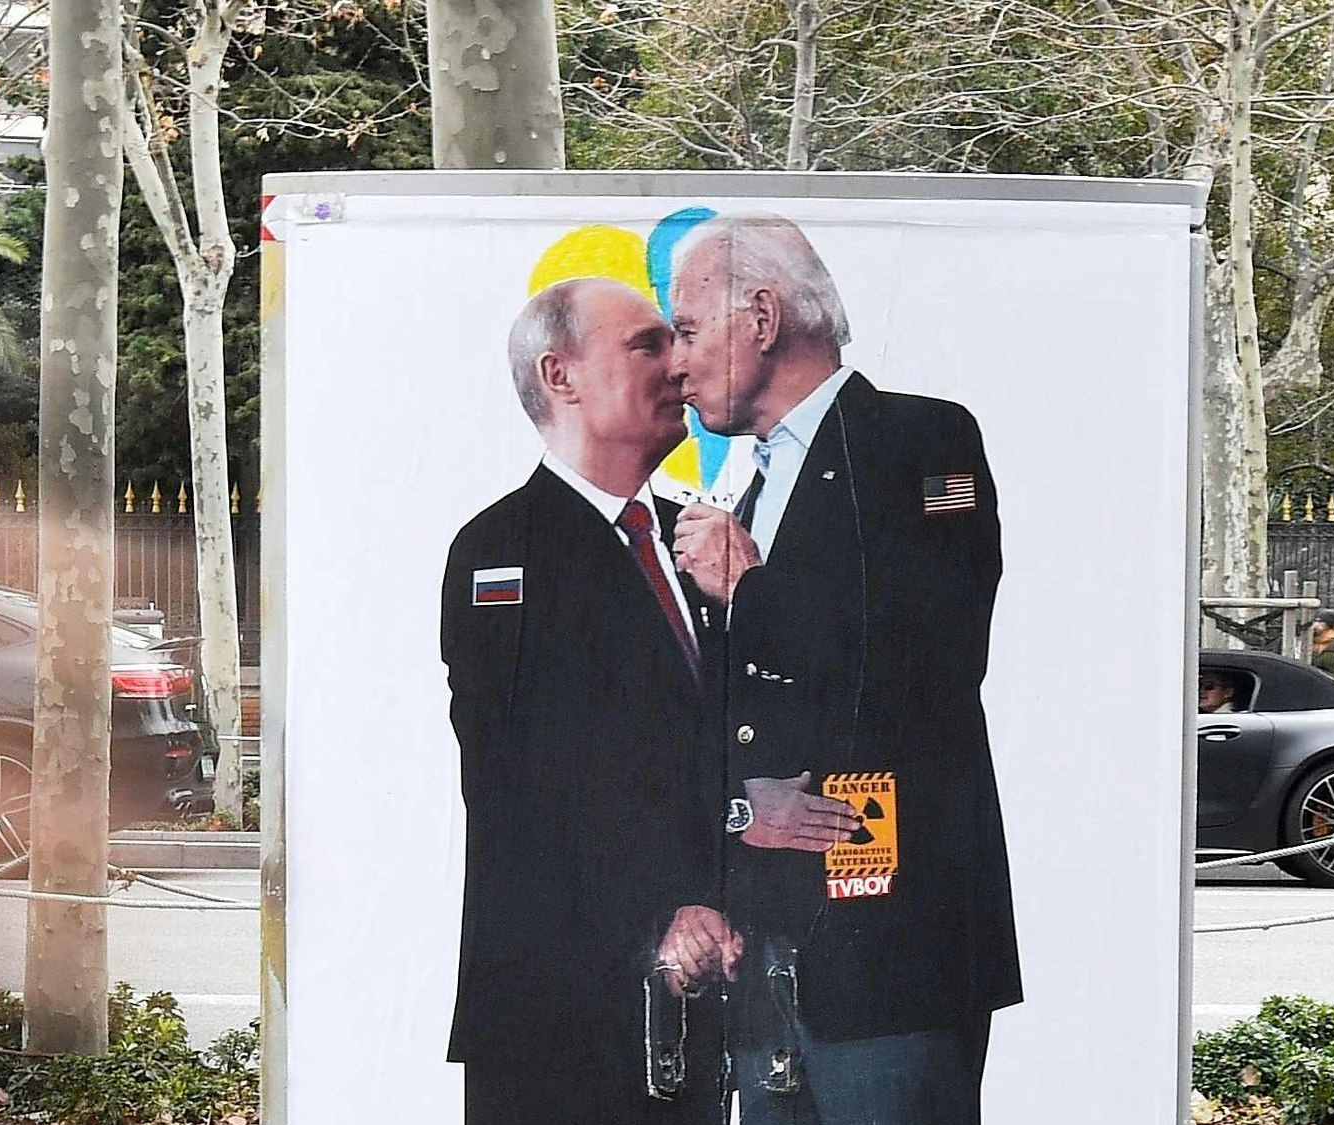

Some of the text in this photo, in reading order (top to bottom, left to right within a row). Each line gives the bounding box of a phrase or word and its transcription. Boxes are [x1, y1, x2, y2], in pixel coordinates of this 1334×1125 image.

[828, 781, 891, 795] DANGER
[830, 846, 892, 857] RADIOACTIVE
[831, 855, 893, 866] MATERIALS
[827, 874, 892, 899] TVBOY
